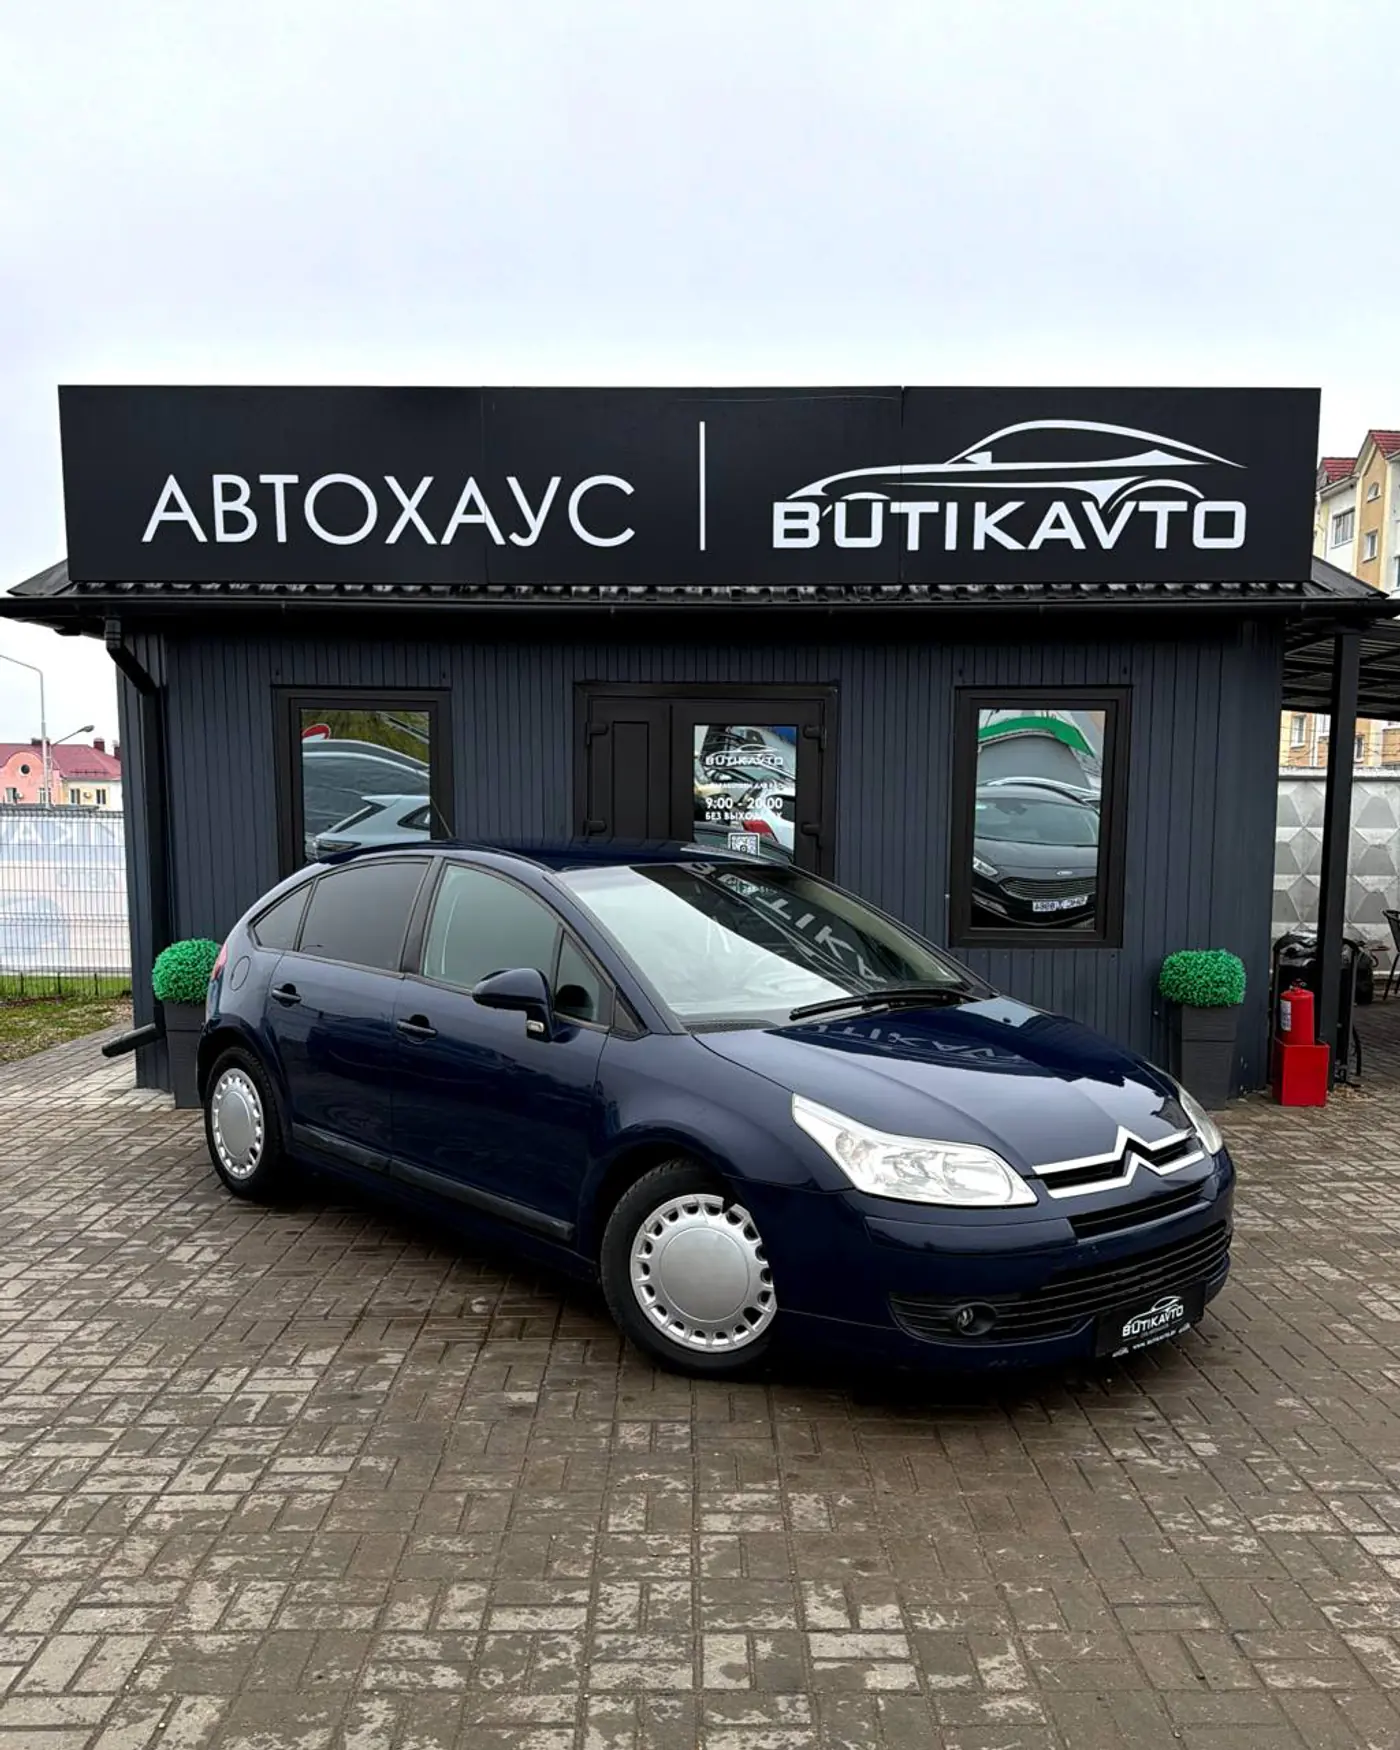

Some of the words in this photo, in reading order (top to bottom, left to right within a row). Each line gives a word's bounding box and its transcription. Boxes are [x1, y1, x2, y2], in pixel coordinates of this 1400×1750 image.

[141, 473, 635, 547] АВТОХАУС
[772, 501, 1247, 551] BUTIKAVTO
[705, 798, 733, 809] 9:00
[746, 797, 783, 809] 2000
[705, 812, 721, 820] БЕЗ
[724, 812, 783, 820] ВЫХОХ
[1122, 1304, 1184, 1337] BUTIKAVTO
